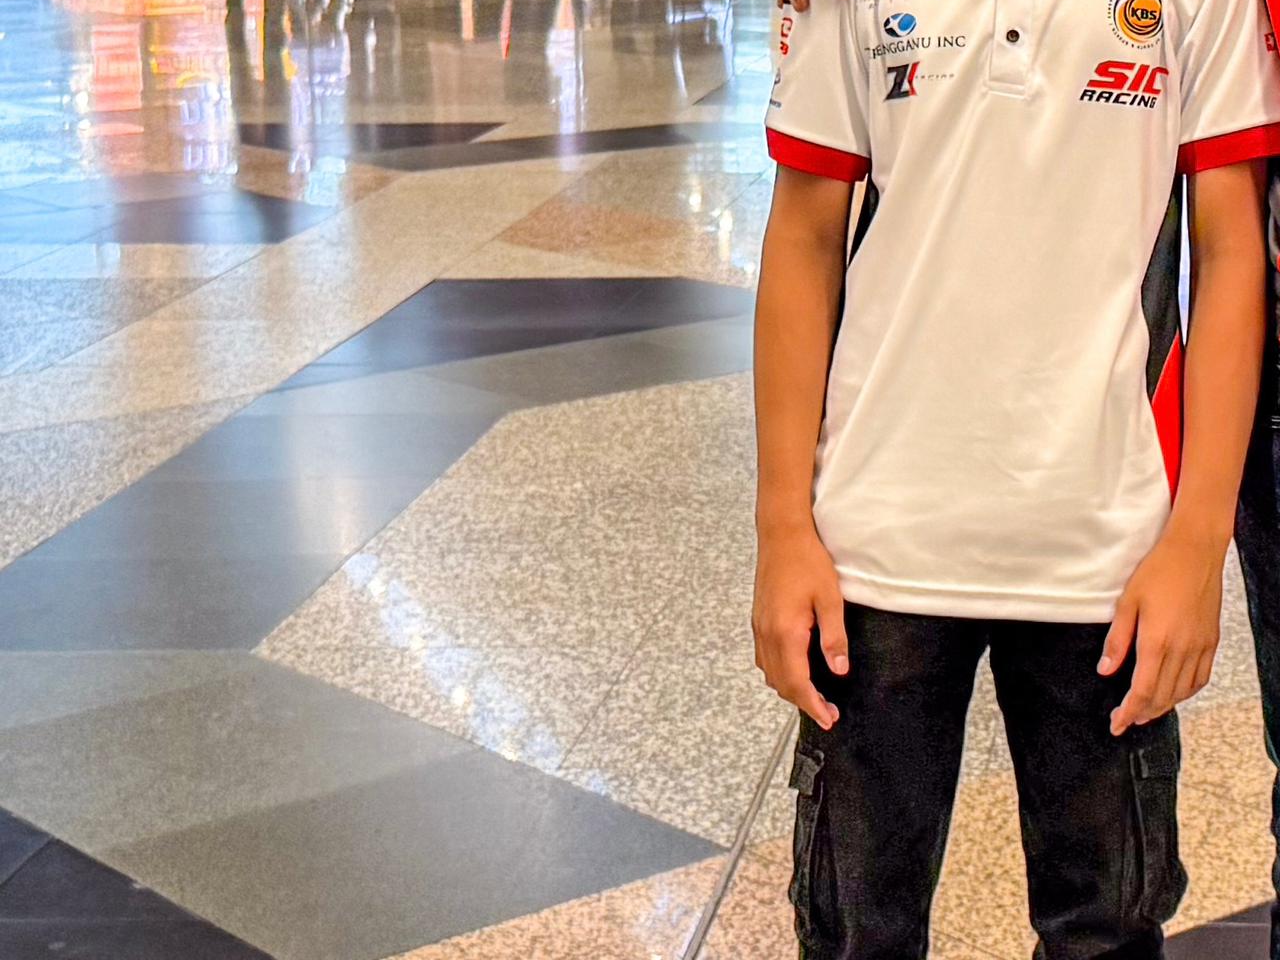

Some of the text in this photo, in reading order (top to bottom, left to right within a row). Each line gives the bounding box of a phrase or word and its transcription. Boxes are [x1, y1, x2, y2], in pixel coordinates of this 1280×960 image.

[1130, 6, 1158, 22] KBS
[937, 35, 967, 49] INC
[1086, 60, 1170, 95] SIC
[1079, 89, 1158, 109] RACING
